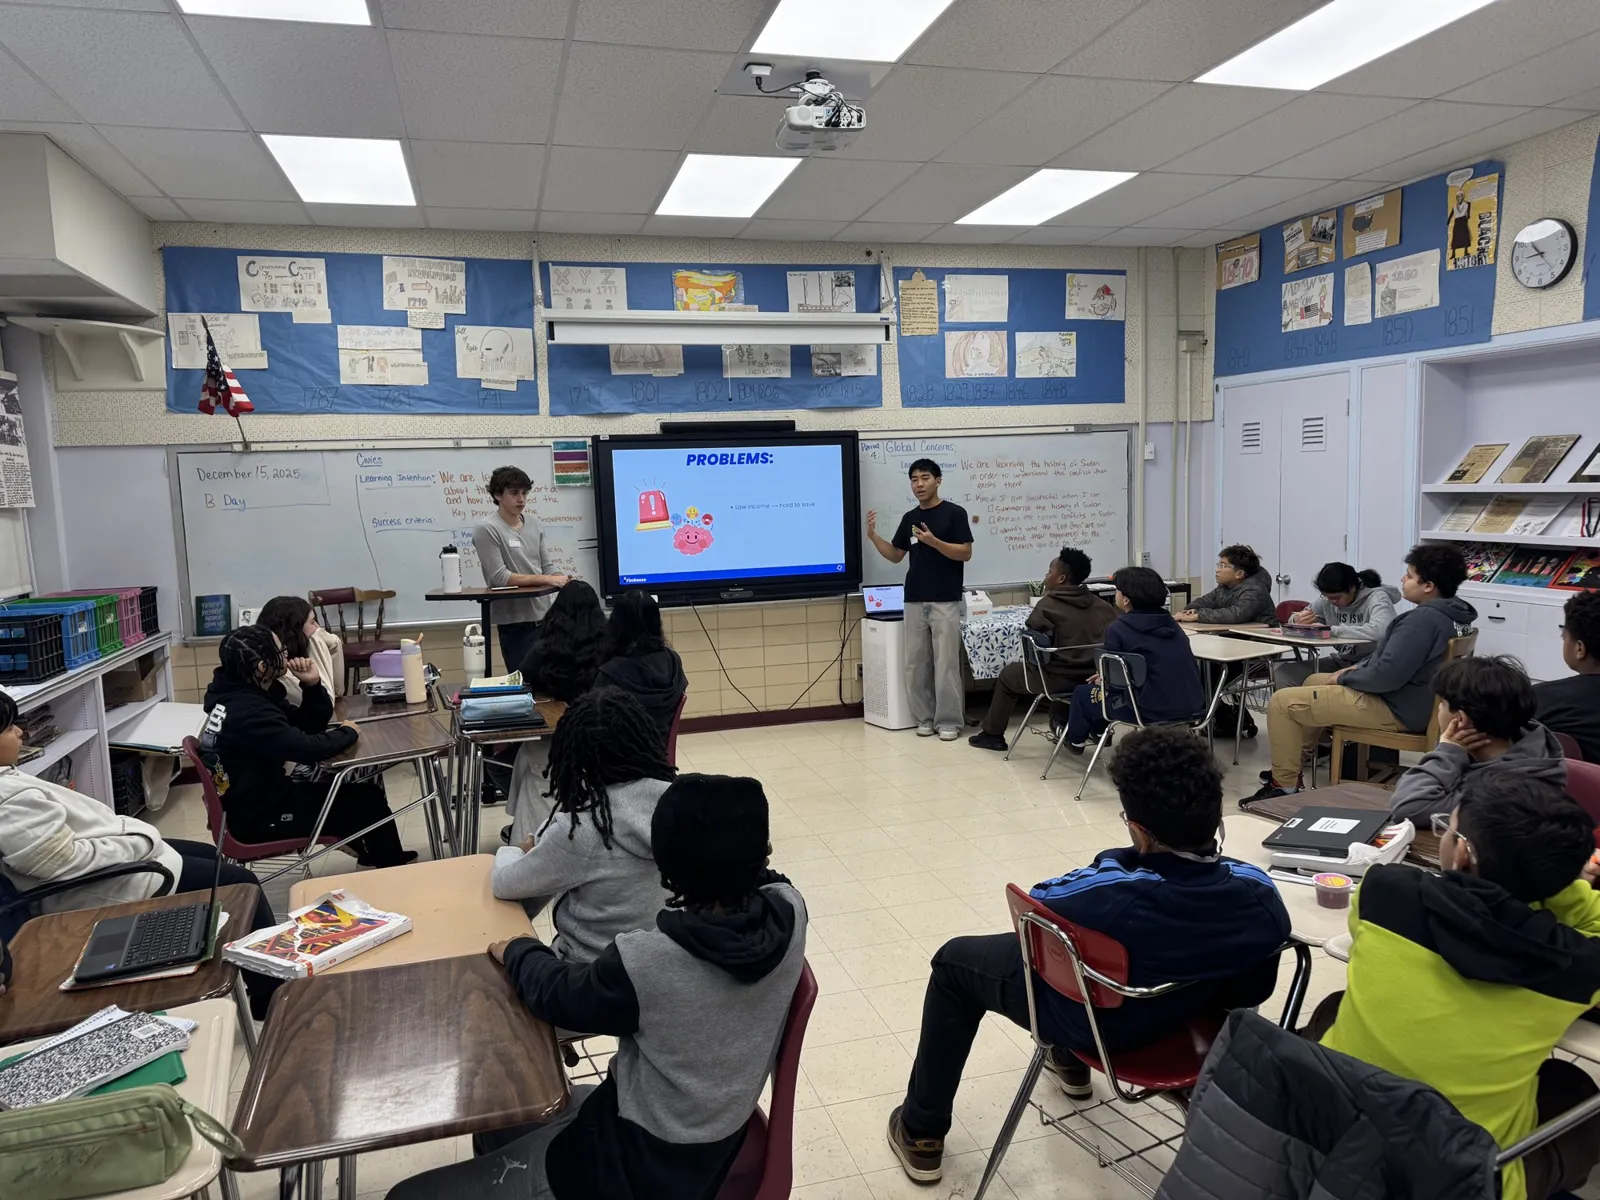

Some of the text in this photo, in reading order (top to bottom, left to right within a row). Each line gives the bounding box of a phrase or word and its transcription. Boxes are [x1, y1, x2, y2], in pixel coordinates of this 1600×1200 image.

[1453, 253, 1489, 269] HISTORY
[553, 268, 615, 286] X Y Z
[1382, 316, 1413, 346] 1850
[1444, 304, 1475, 337] 1851
[303, 387, 339, 409] 1787
[631, 381, 659, 404] 1801
[904, 385, 934, 402] 1828
[1005, 381, 1028, 400] 1846
[1041, 380, 1067, 399] 1848
[886, 441, 916, 453] Global
[356, 452, 383, 466] Civics
[686, 451, 774, 467] PROBLEMS:
[961, 459, 974, 470] We
[996, 459, 1024, 473] learning
[1030, 460, 1040, 468] the
[1043, 459, 1066, 470] history
[196, 465, 301, 481] December 15, 2025
[360, 474, 392, 487] Learning
[439, 470, 455, 483] We
[460, 473, 475, 482] are
[979, 472, 998, 480] order
[1013, 470, 1048, 479] understand
[444, 486, 468, 496] about
[965, 493, 971, 502] I
[204, 493, 246, 511] B Day
[445, 496, 461, 504] and
[467, 496, 483, 504] how
[1051, 501, 1071, 511] history
[372, 517, 401, 528] Success
[453, 531, 459, 539] I
